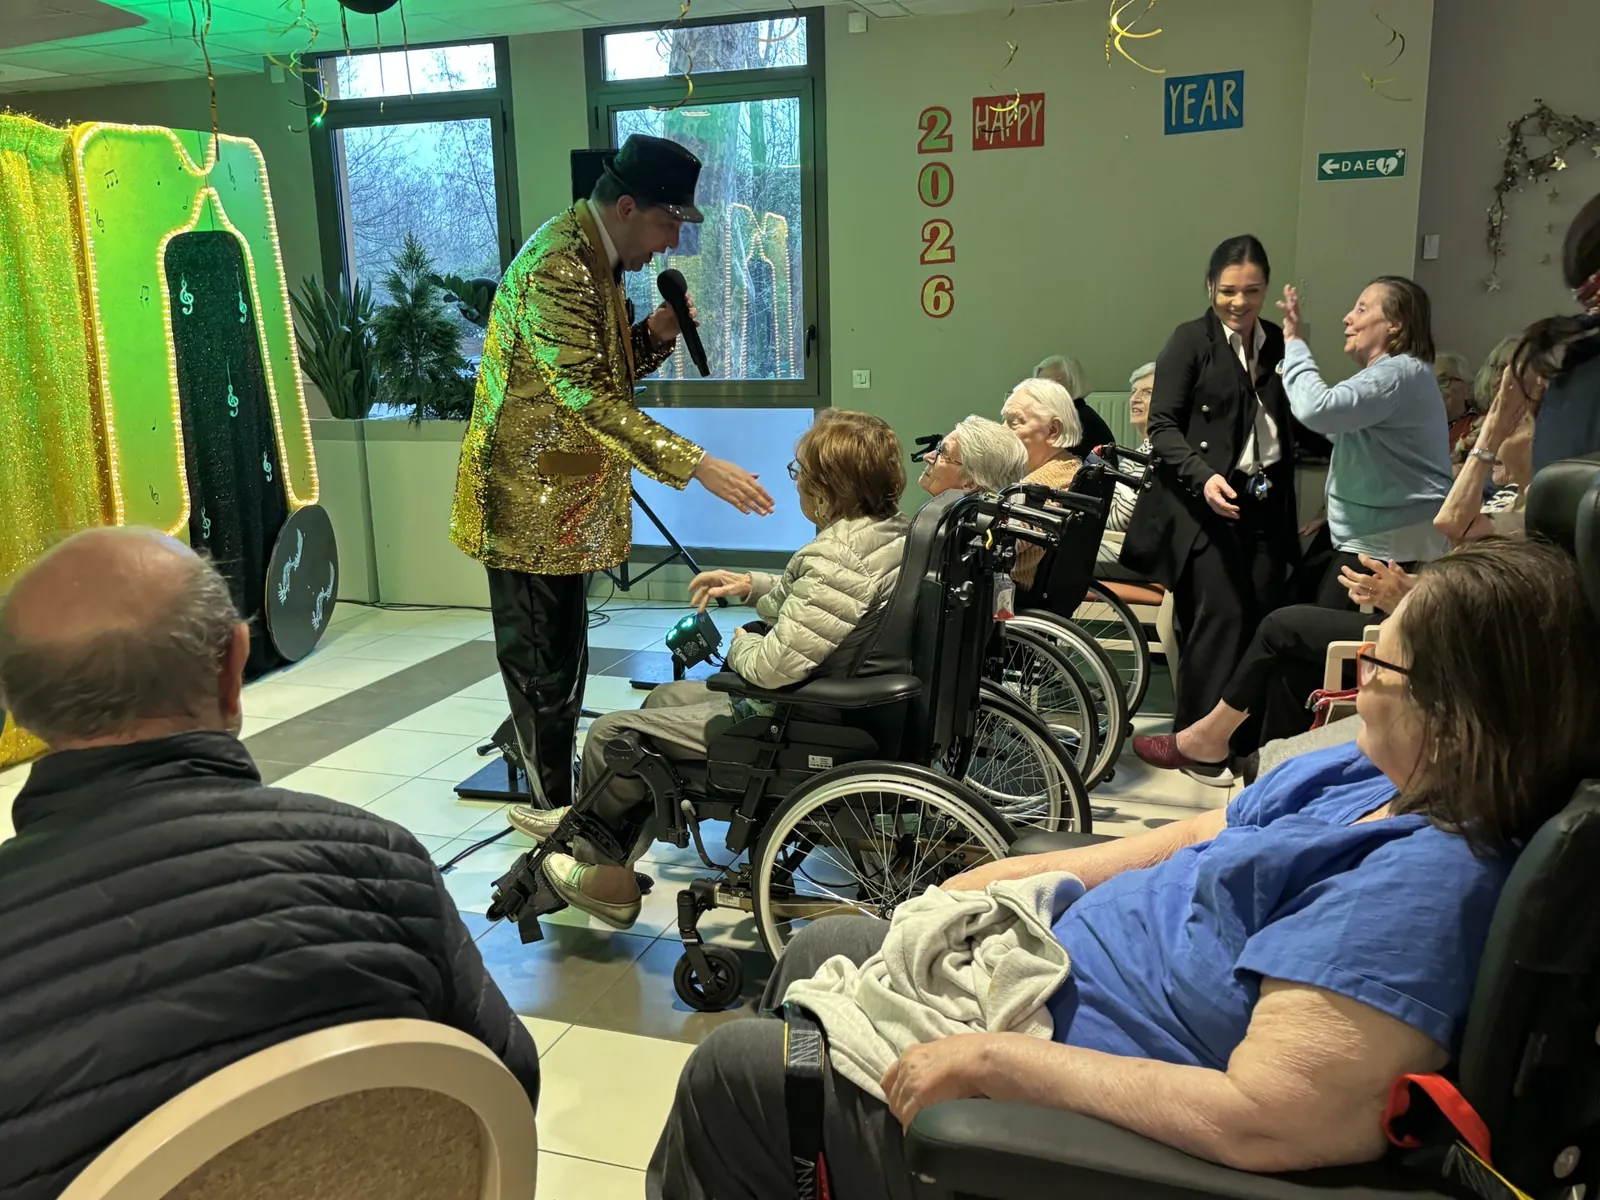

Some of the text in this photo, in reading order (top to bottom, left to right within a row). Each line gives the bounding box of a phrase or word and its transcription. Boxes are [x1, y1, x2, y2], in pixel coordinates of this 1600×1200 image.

[975, 99, 1043, 145] HAPPY
[1168, 79, 1239, 127] YEAR
[1341, 159, 1376, 172] DAE
[917, 106, 956, 319] 2026
